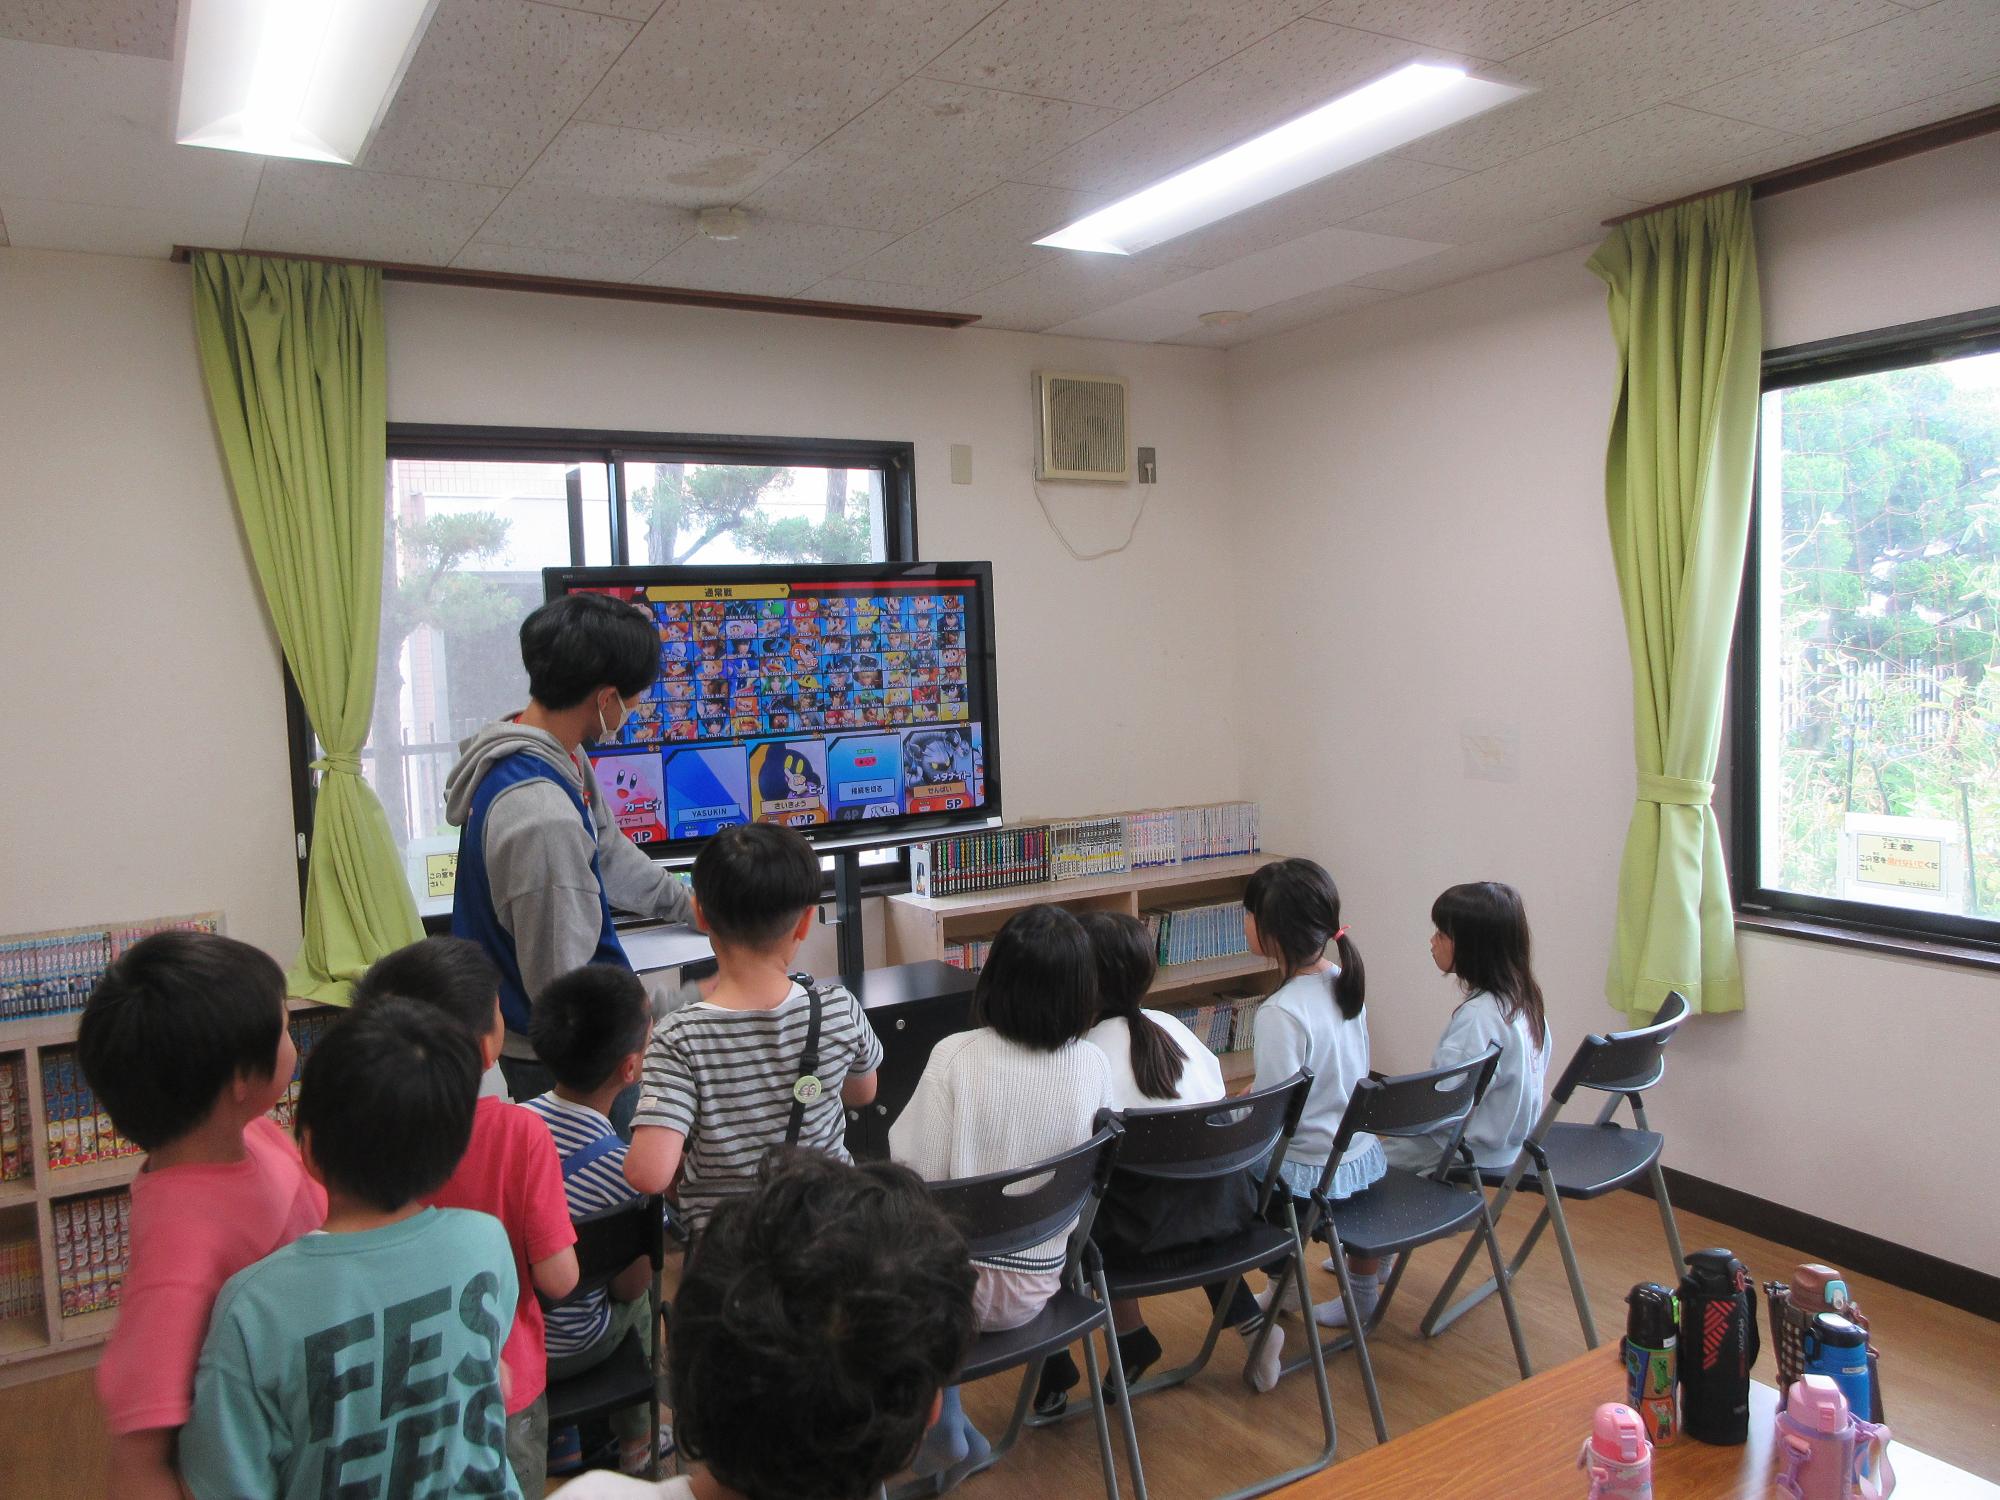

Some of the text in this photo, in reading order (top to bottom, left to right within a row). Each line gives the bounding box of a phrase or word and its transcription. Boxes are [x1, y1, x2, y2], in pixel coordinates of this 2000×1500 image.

[704, 587, 733, 598] 通常戦
[932, 771, 972, 783] メタナイト
[851, 785, 883, 795] 接続を切る
[624, 800, 663, 812] カービィ
[945, 798, 963, 810] 5P
[691, 807, 728, 818] YASUKIN
[843, 809, 860, 821] 4P
[615, 816, 644, 827] イヤー1
[632, 830, 653, 844] 1P
[304, 1271, 500, 1444] FES
